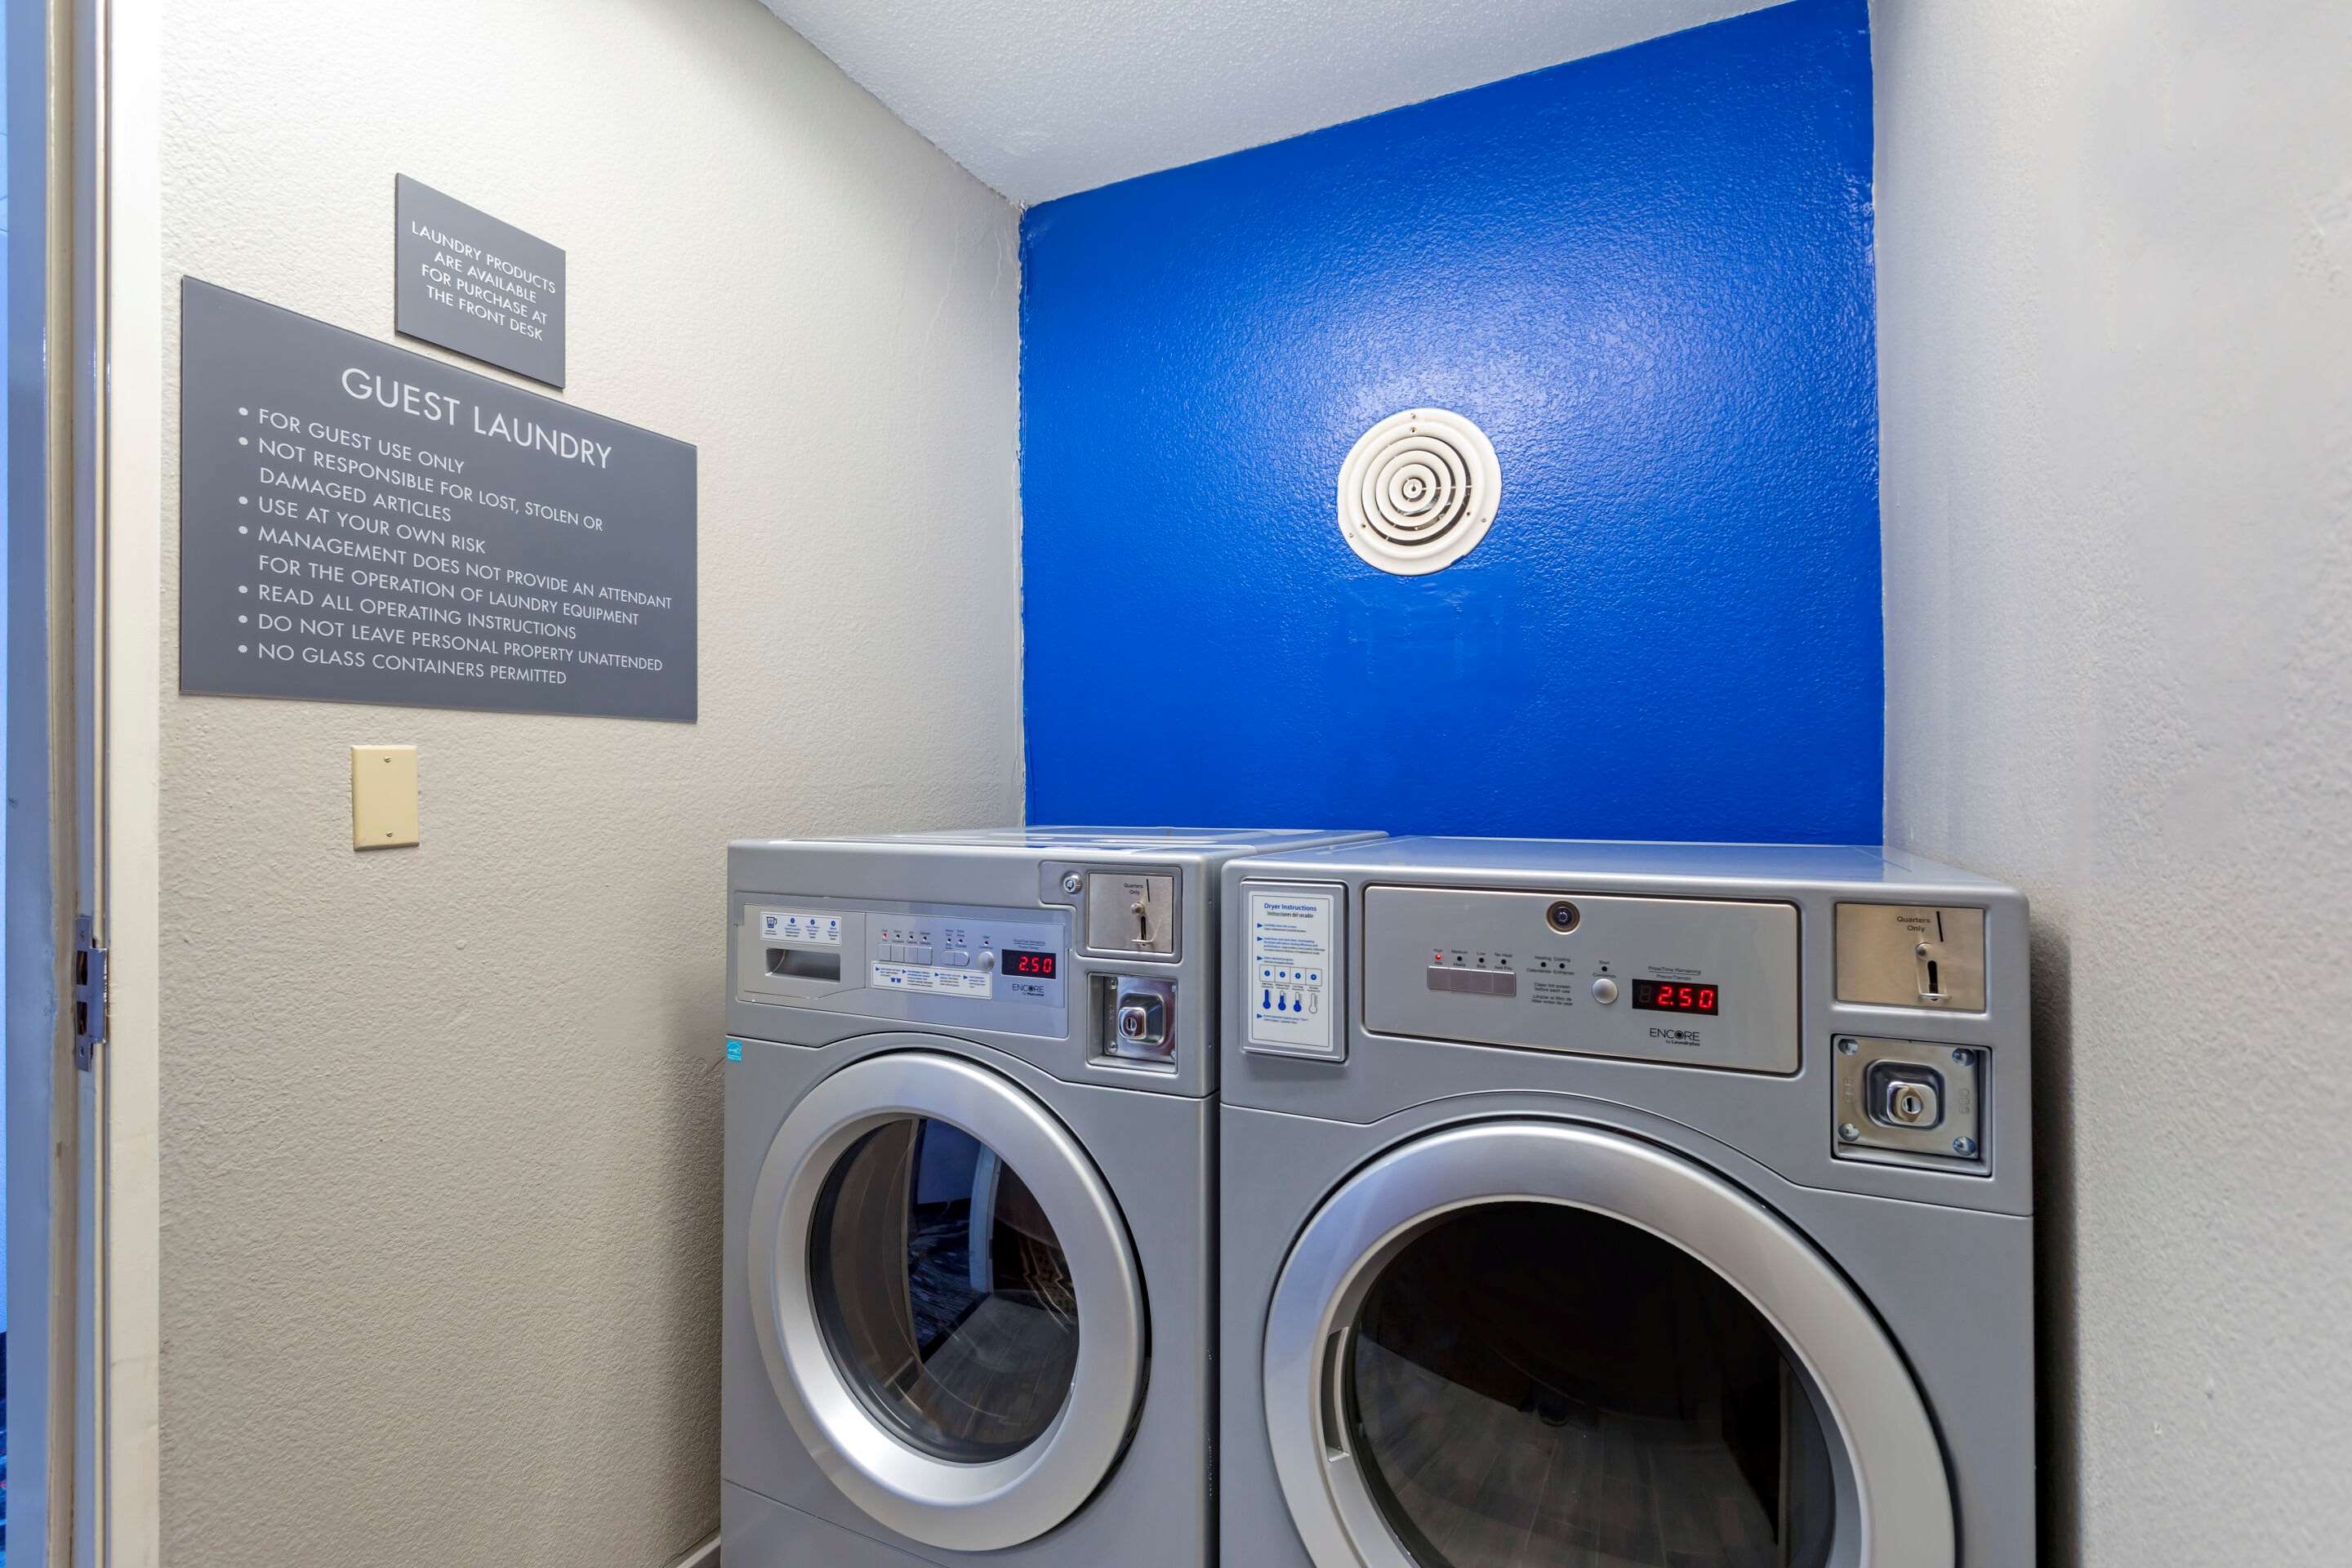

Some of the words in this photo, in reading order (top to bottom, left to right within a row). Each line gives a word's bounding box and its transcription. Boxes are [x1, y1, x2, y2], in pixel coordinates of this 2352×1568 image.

[412, 219, 482, 261] LAUNDRY
[486, 253, 556, 294] PRODUCTS
[434, 251, 463, 273] ARE
[467, 265, 537, 304] AVAILABLE
[421, 263, 452, 287] FOR
[456, 278, 528, 318] PURCHASE
[531, 310, 548, 325] AT
[426, 283, 454, 307] THE
[457, 297, 506, 327] FRONT
[510, 318, 543, 342] DESK
[259, 408, 301, 434] FOR
[308, 421, 372, 451] GUEST
[378, 439, 412, 462] USE
[417, 450, 465, 474] ONLY
[341, 367, 461, 425] GUEST
[474, 405, 613, 470] LAUNDRY
[258, 437, 306, 463] NOT
[313, 450, 434, 493] RESPONSIBLE
[440, 480, 474, 502] FOR
[479, 490, 519, 515] LOST,
[524, 501, 579, 526] STOLEN
[582, 515, 604, 532] OR
[260, 466, 367, 504] DAMAGED
[372, 492, 452, 523] ARTICLES
[258, 496, 298, 519] USE
[305, 506, 330, 524] AT
[336, 510, 390, 537] YOUR
[396, 523, 445, 546] OWN
[451, 534, 486, 555] RISK
[257, 525, 408, 565] MANAGEMENT
[412, 552, 460, 574] DOES
[466, 562, 501, 581] NOT
[506, 569, 568, 593] PROVIDE
[572, 581, 595, 597] AN
[598, 586, 672, 609] ATTENDANT
[259, 555, 301, 577] FOR
[308, 562, 345, 582] THE
[350, 569, 455, 599] OPERATION
[460, 586, 483, 603] OF
[489, 590, 559, 613] LAUNDRY
[563, 602, 639, 626] EQUIPMENT
[259, 584, 314, 606] READ
[320, 593, 354, 612] ALL
[359, 598, 462, 625] OPERATING
[467, 612, 577, 639] INSTRUCTIONS
[258, 612, 292, 632] DO
[300, 618, 345, 638] NOT
[352, 624, 405, 644] LEAVE
[412, 630, 499, 654] PERSONAL
[504, 641, 574, 662] PROPERTY
[578, 650, 663, 671] UNATTENDED
[258, 642, 295, 662] NO
[301, 647, 365, 667] GLASS
[372, 653, 484, 678] CONTAINERS
[490, 664, 567, 684] PERMITTED
[1263, 902, 1281, 911] Dryer
[1281, 903, 1317, 911] Instructions
[1896, 915, 1931, 924] Quarters
[1907, 924, 1926, 933] Only
[1012, 983, 1045, 994] ENCORE
[1019, 956, 1052, 973] 2.50
[1659, 986, 1713, 1008] 2.50
[1650, 1027, 1700, 1041] ENCORE
